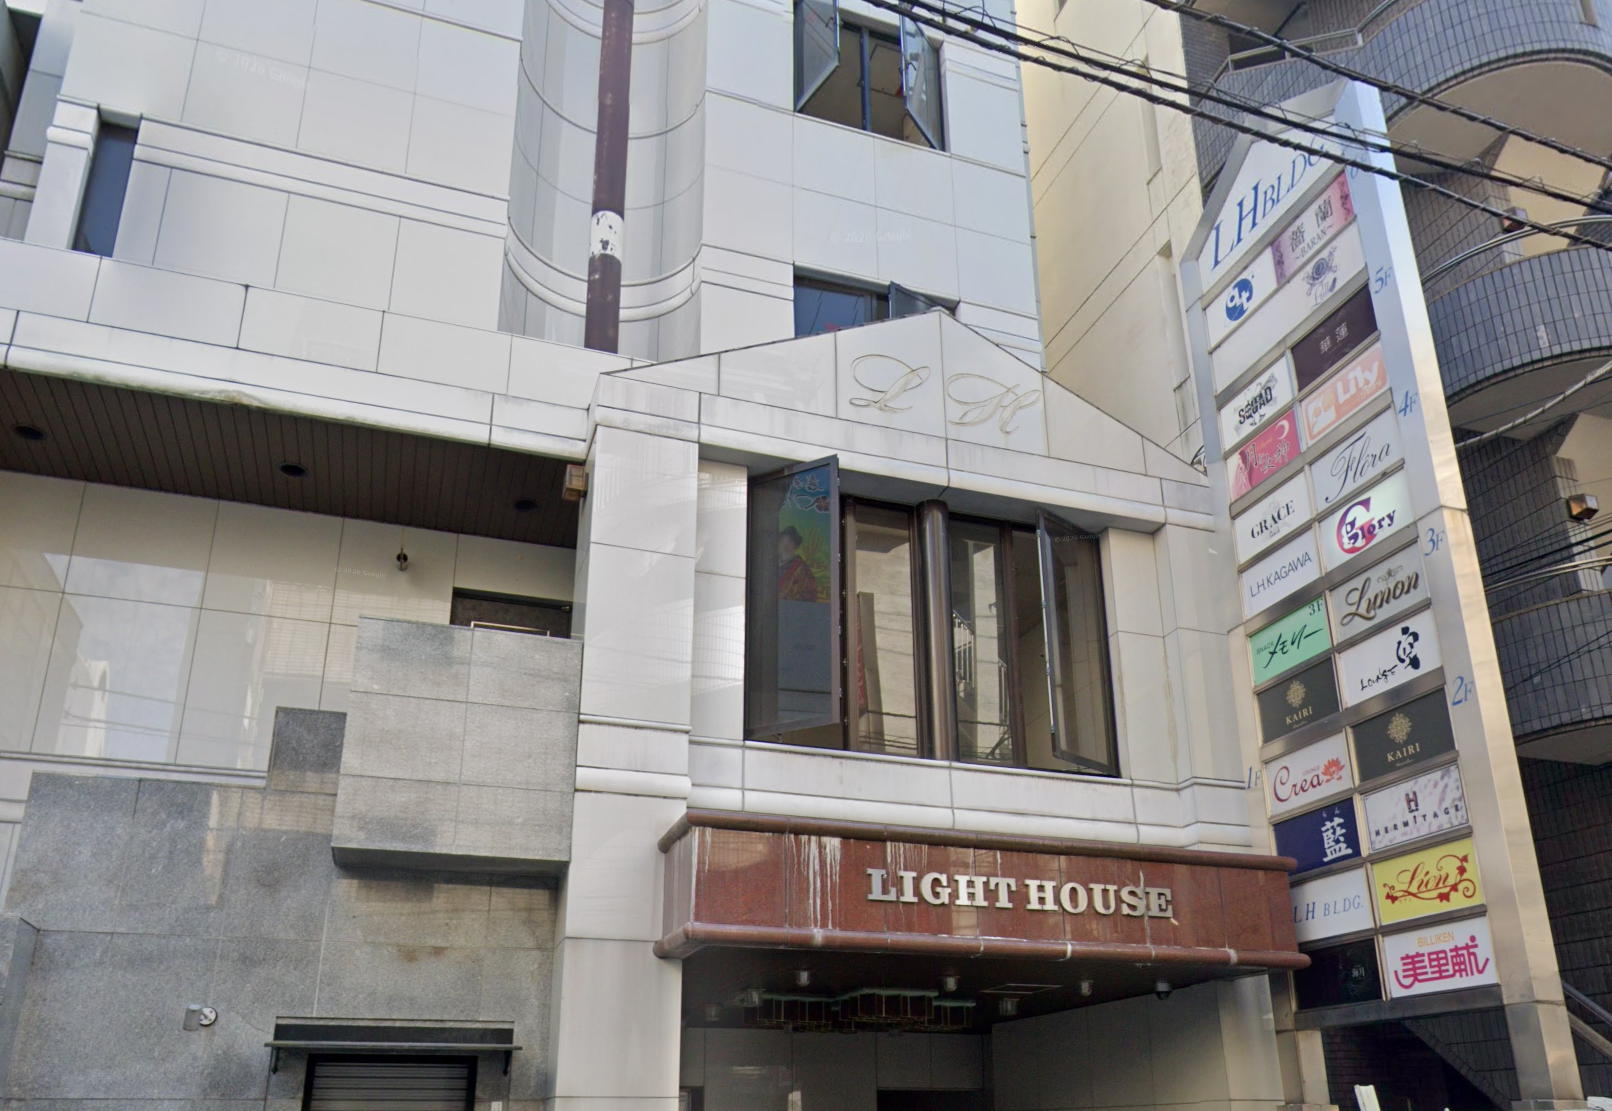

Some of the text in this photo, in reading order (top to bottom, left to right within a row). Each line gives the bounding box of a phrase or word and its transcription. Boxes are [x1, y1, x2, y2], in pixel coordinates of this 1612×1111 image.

[1374, 266, 1392, 295] 5F
[1336, 361, 1379, 404] Lily
[1398, 389, 1419, 417] 4F
[1251, 500, 1294, 539] GRACE
[1424, 528, 1445, 556] 3F
[1308, 598, 1324, 616] 3F
[1451, 676, 1473, 707] 2F
[1285, 706, 1313, 726] KAIRI
[1386, 743, 1421, 763] KAIRI
[1245, 765, 1262, 791] 1F
[1273, 765, 1325, 803] Crea
[1374, 802, 1461, 838] HERMITAGE
[1321, 816, 1353, 863] 藍
[867, 867, 1173, 919] LIGHT HOUSE
[1293, 904, 1315, 924] LH
[1416, 931, 1455, 948] BILLIKEN
